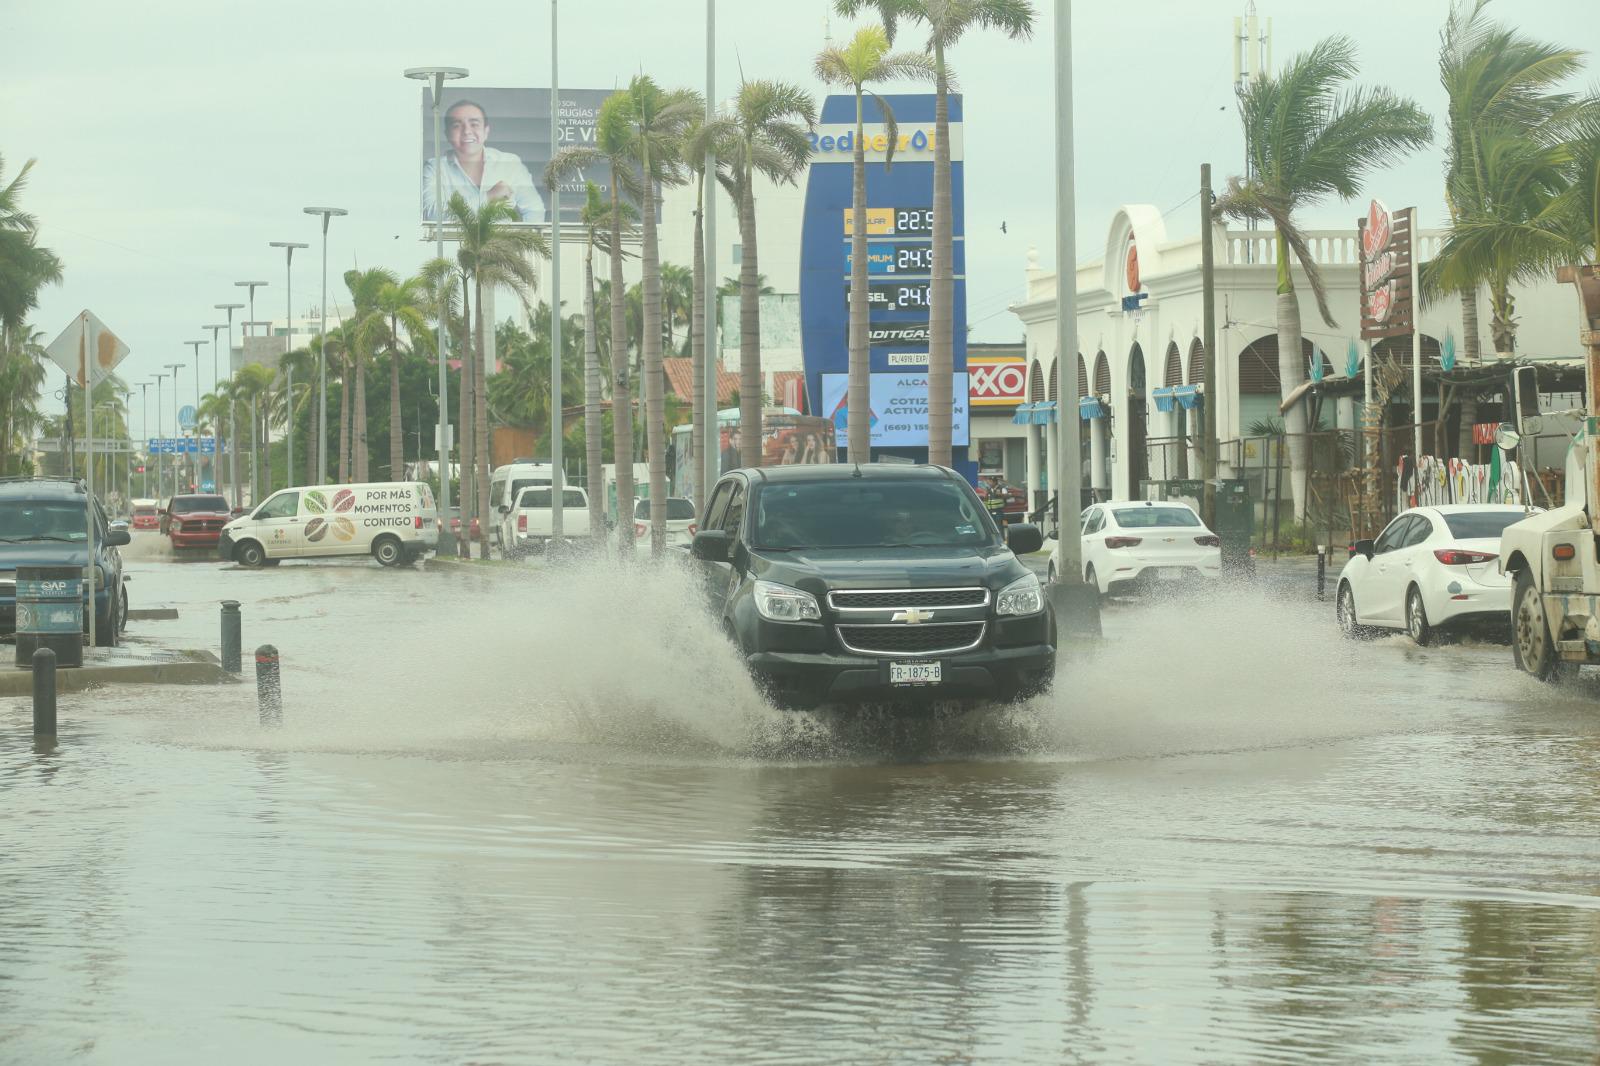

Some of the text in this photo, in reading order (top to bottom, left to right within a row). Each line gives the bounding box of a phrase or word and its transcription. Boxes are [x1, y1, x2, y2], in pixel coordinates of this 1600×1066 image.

[555, 107, 593, 117] IRUGÍAS
[847, 254, 893, 263] PMIUM
[970, 364, 1024, 395] XXO
[884, 424, 911, 432] (669)
[366, 488, 411, 500] POR MÁS
[354, 503, 411, 514] MOMENTOS
[363, 516, 411, 527] CONTIGO
[891, 666, 940, 680] FR-1875-B
